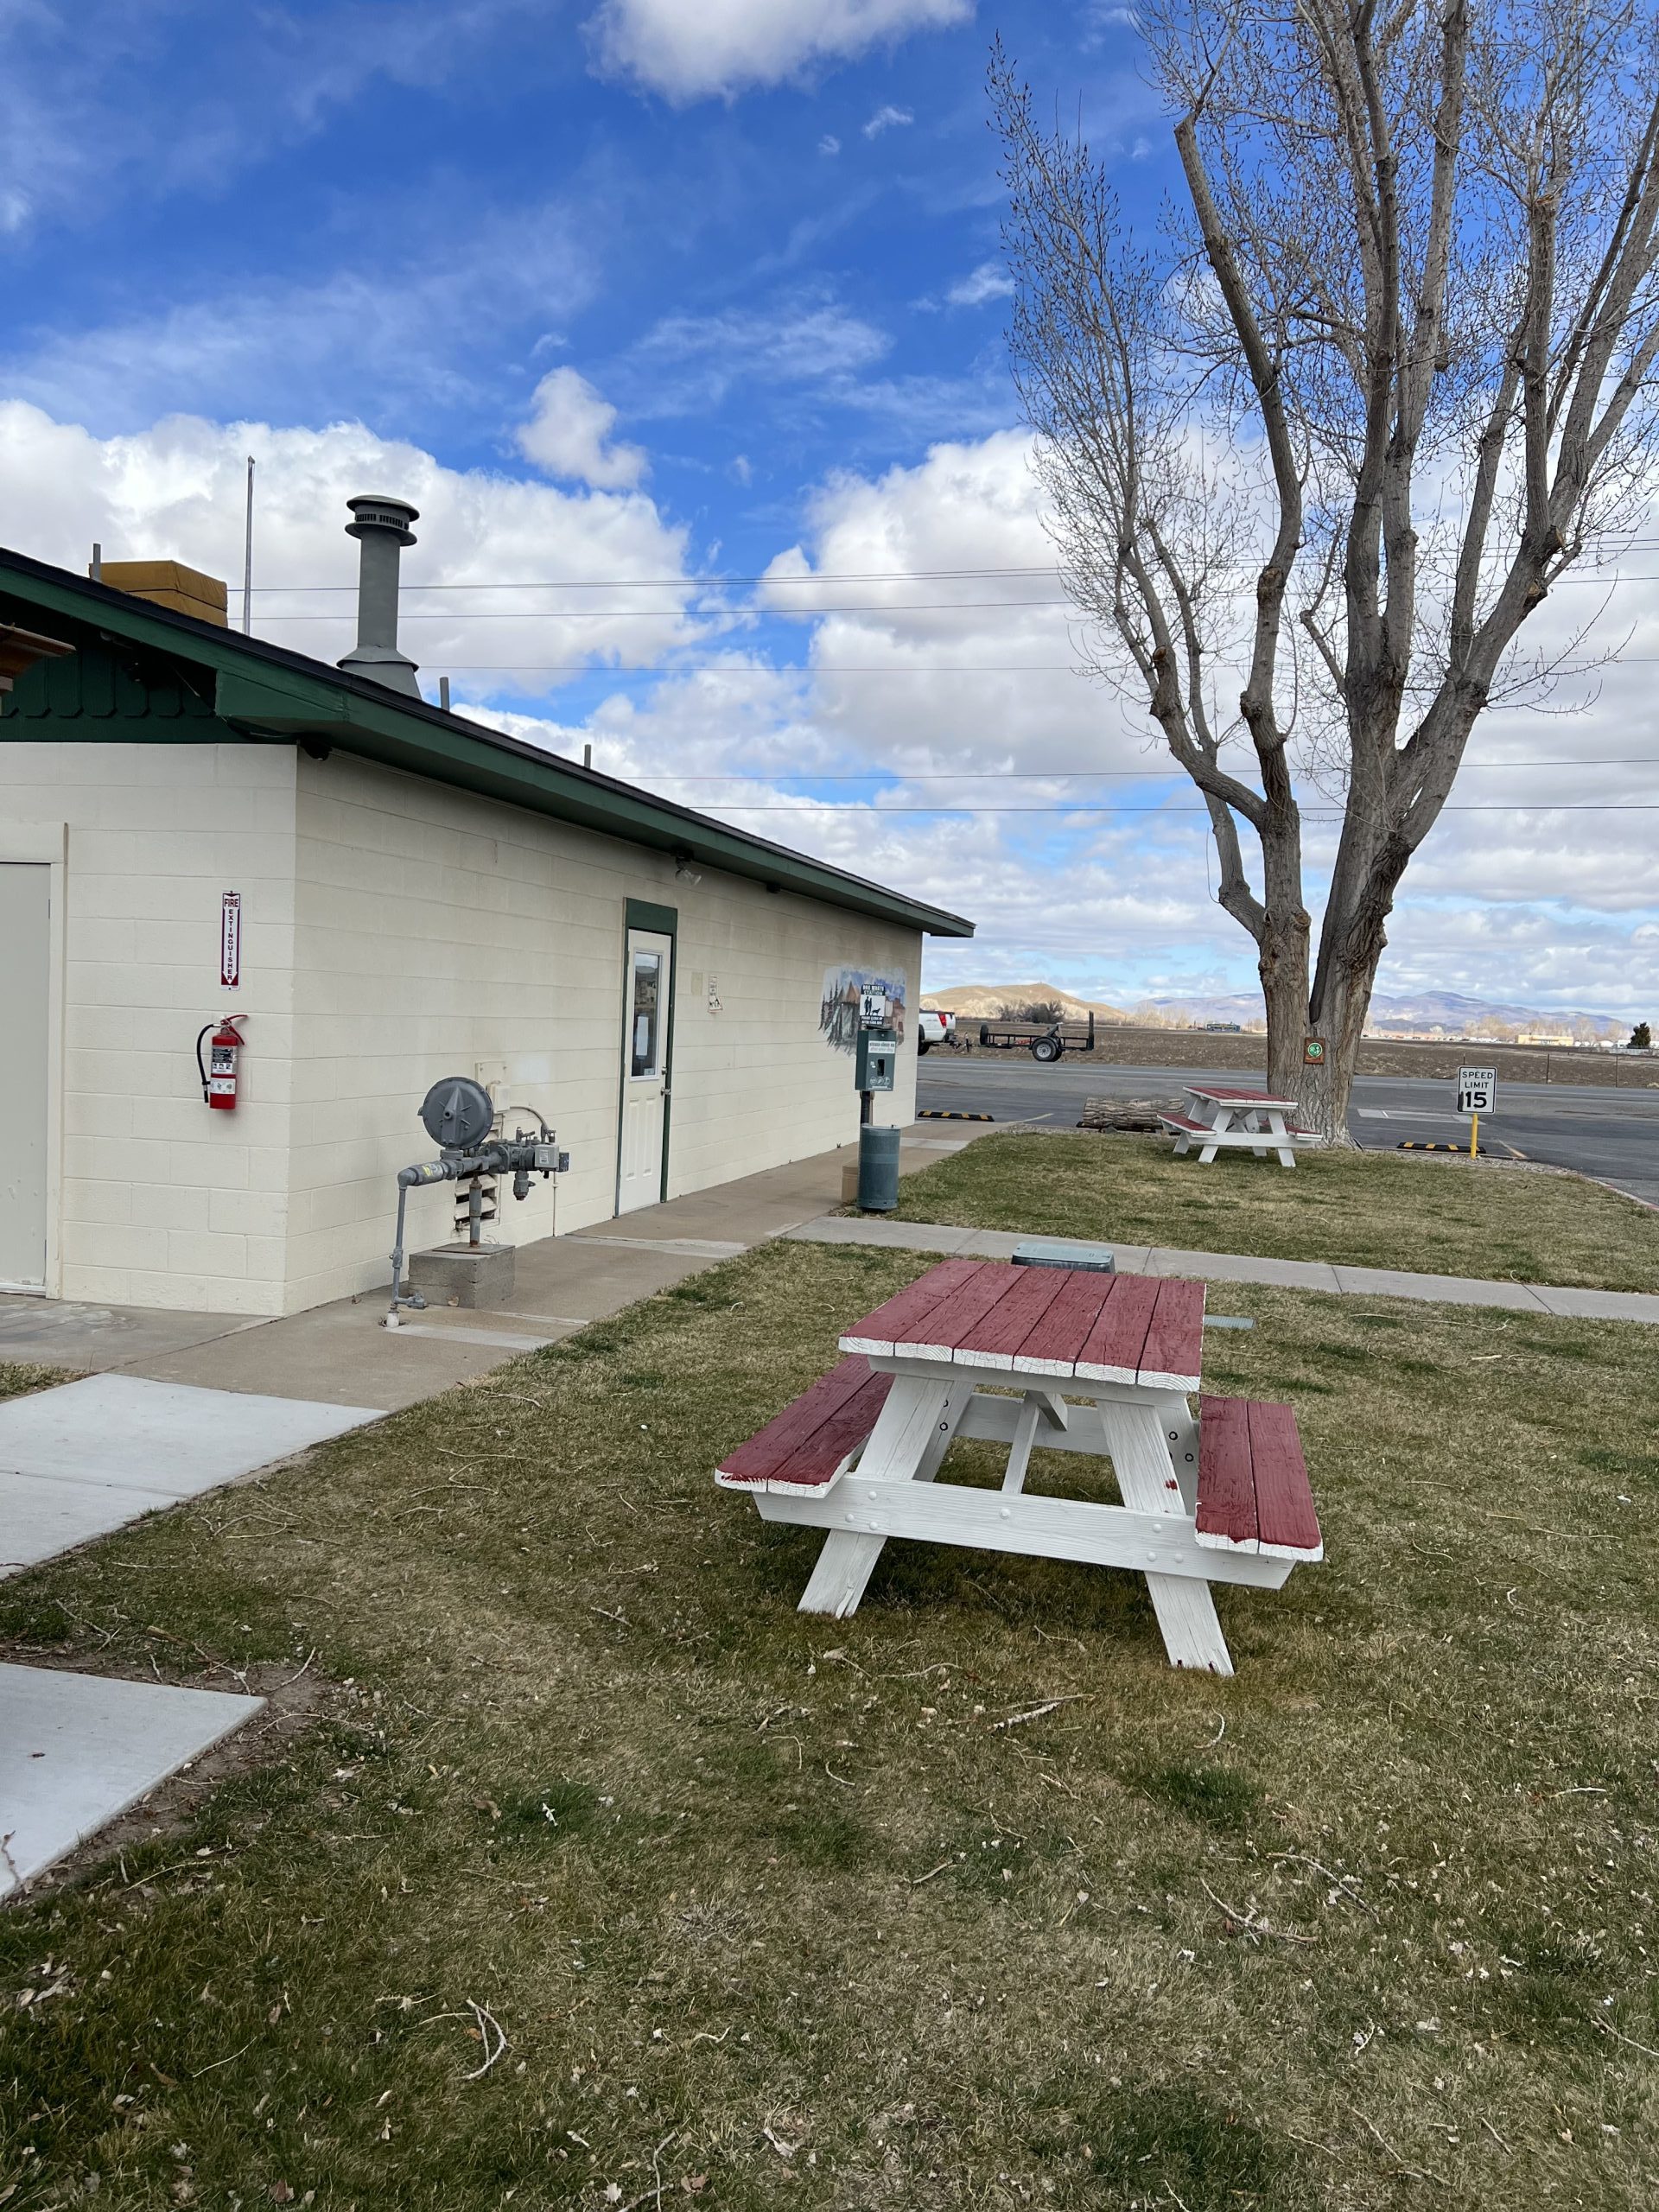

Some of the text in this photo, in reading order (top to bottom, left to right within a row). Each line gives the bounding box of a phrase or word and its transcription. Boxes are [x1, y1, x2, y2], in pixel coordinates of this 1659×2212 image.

[224, 898, 239, 908] FIRE
[1461, 1071, 1493, 1079] SPEED
[1465, 1090, 1487, 1109] 15
